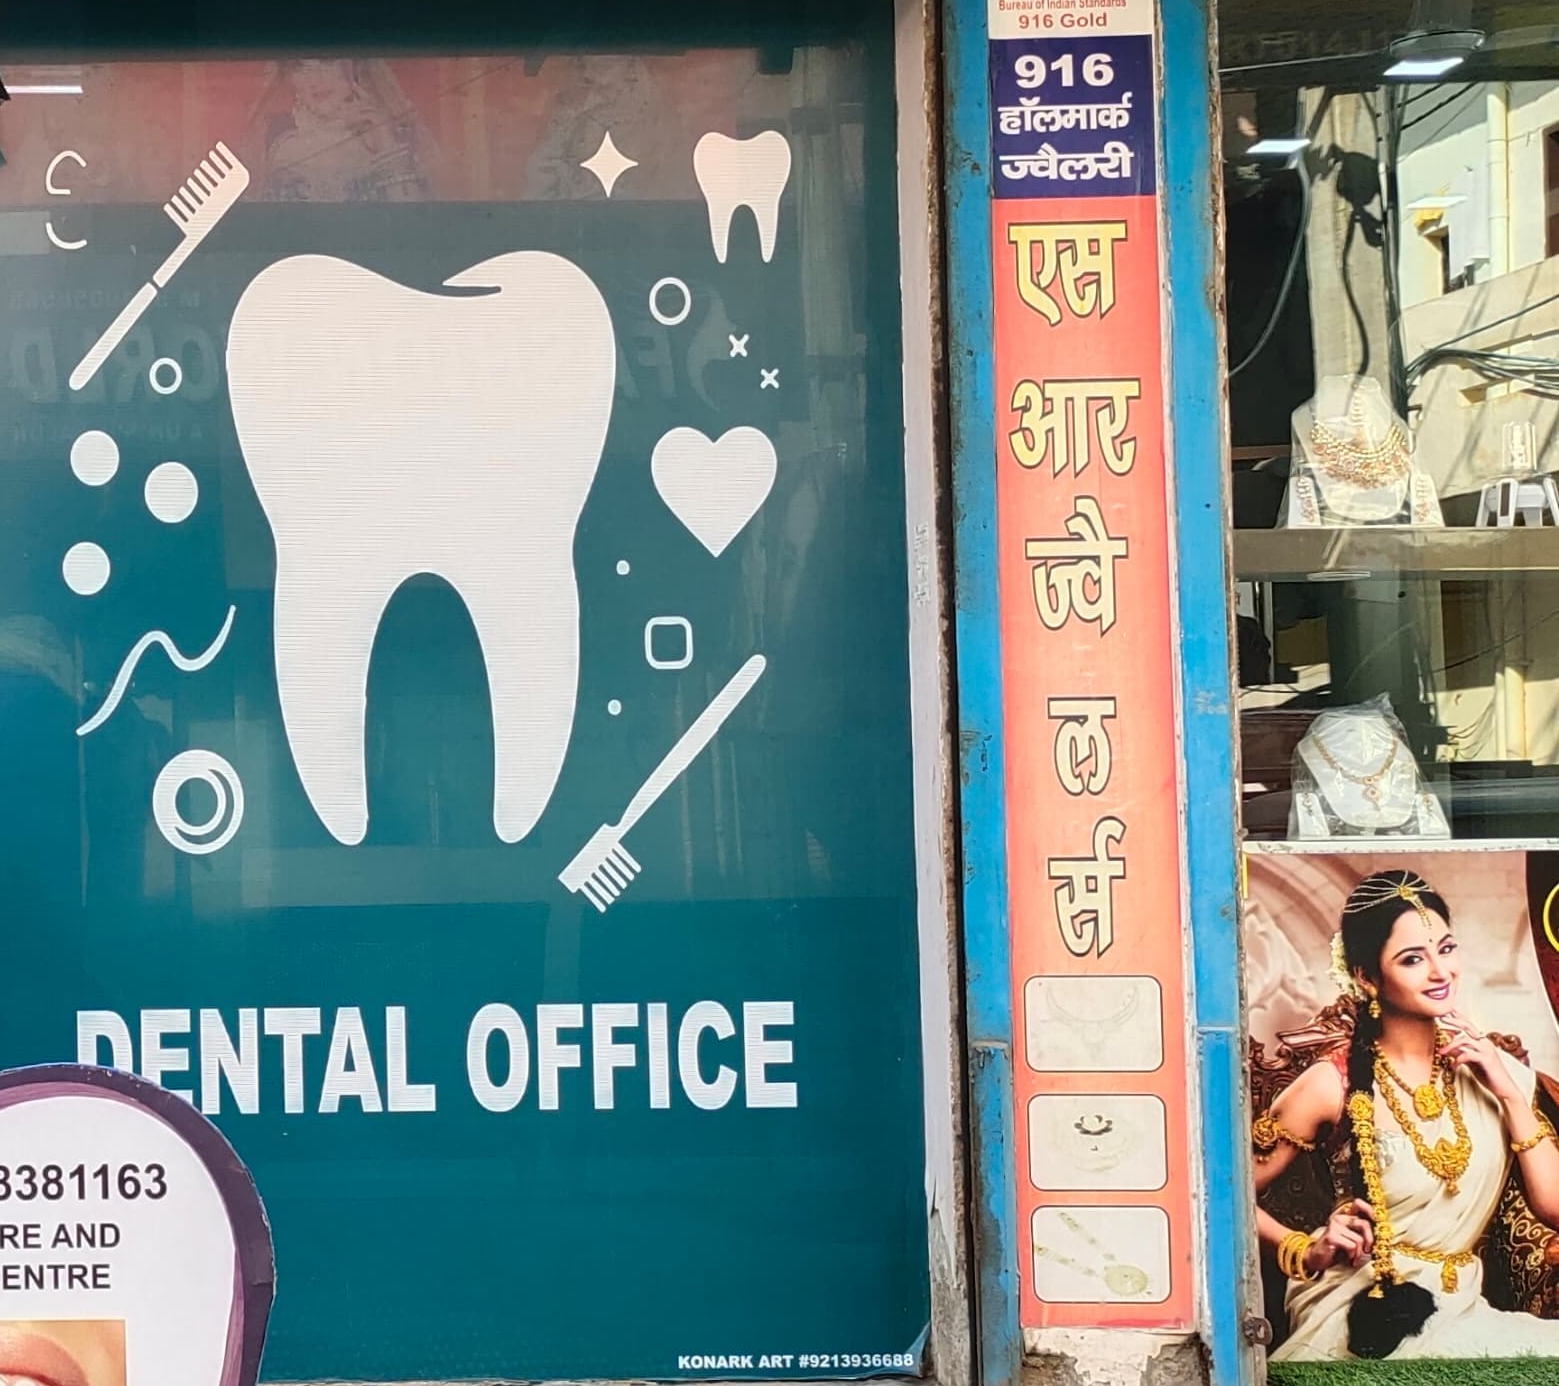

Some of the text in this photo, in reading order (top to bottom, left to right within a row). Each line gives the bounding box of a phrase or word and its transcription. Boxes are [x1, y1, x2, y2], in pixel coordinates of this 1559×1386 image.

[998, 0, 1033, 12] Bureau
[1018, 12, 1108, 30] 916 Gold
[1014, 52, 1115, 89] 916
[997, 91, 1133, 134] हॉलमार्क
[1009, 219, 1128, 326] एस
[1009, 377, 1141, 479] आर
[465, 999, 800, 1114] OFFICE
[50, 1222, 122, 1251] AND
[678, 1352, 916, 1371] KONARK ART #9213936688
